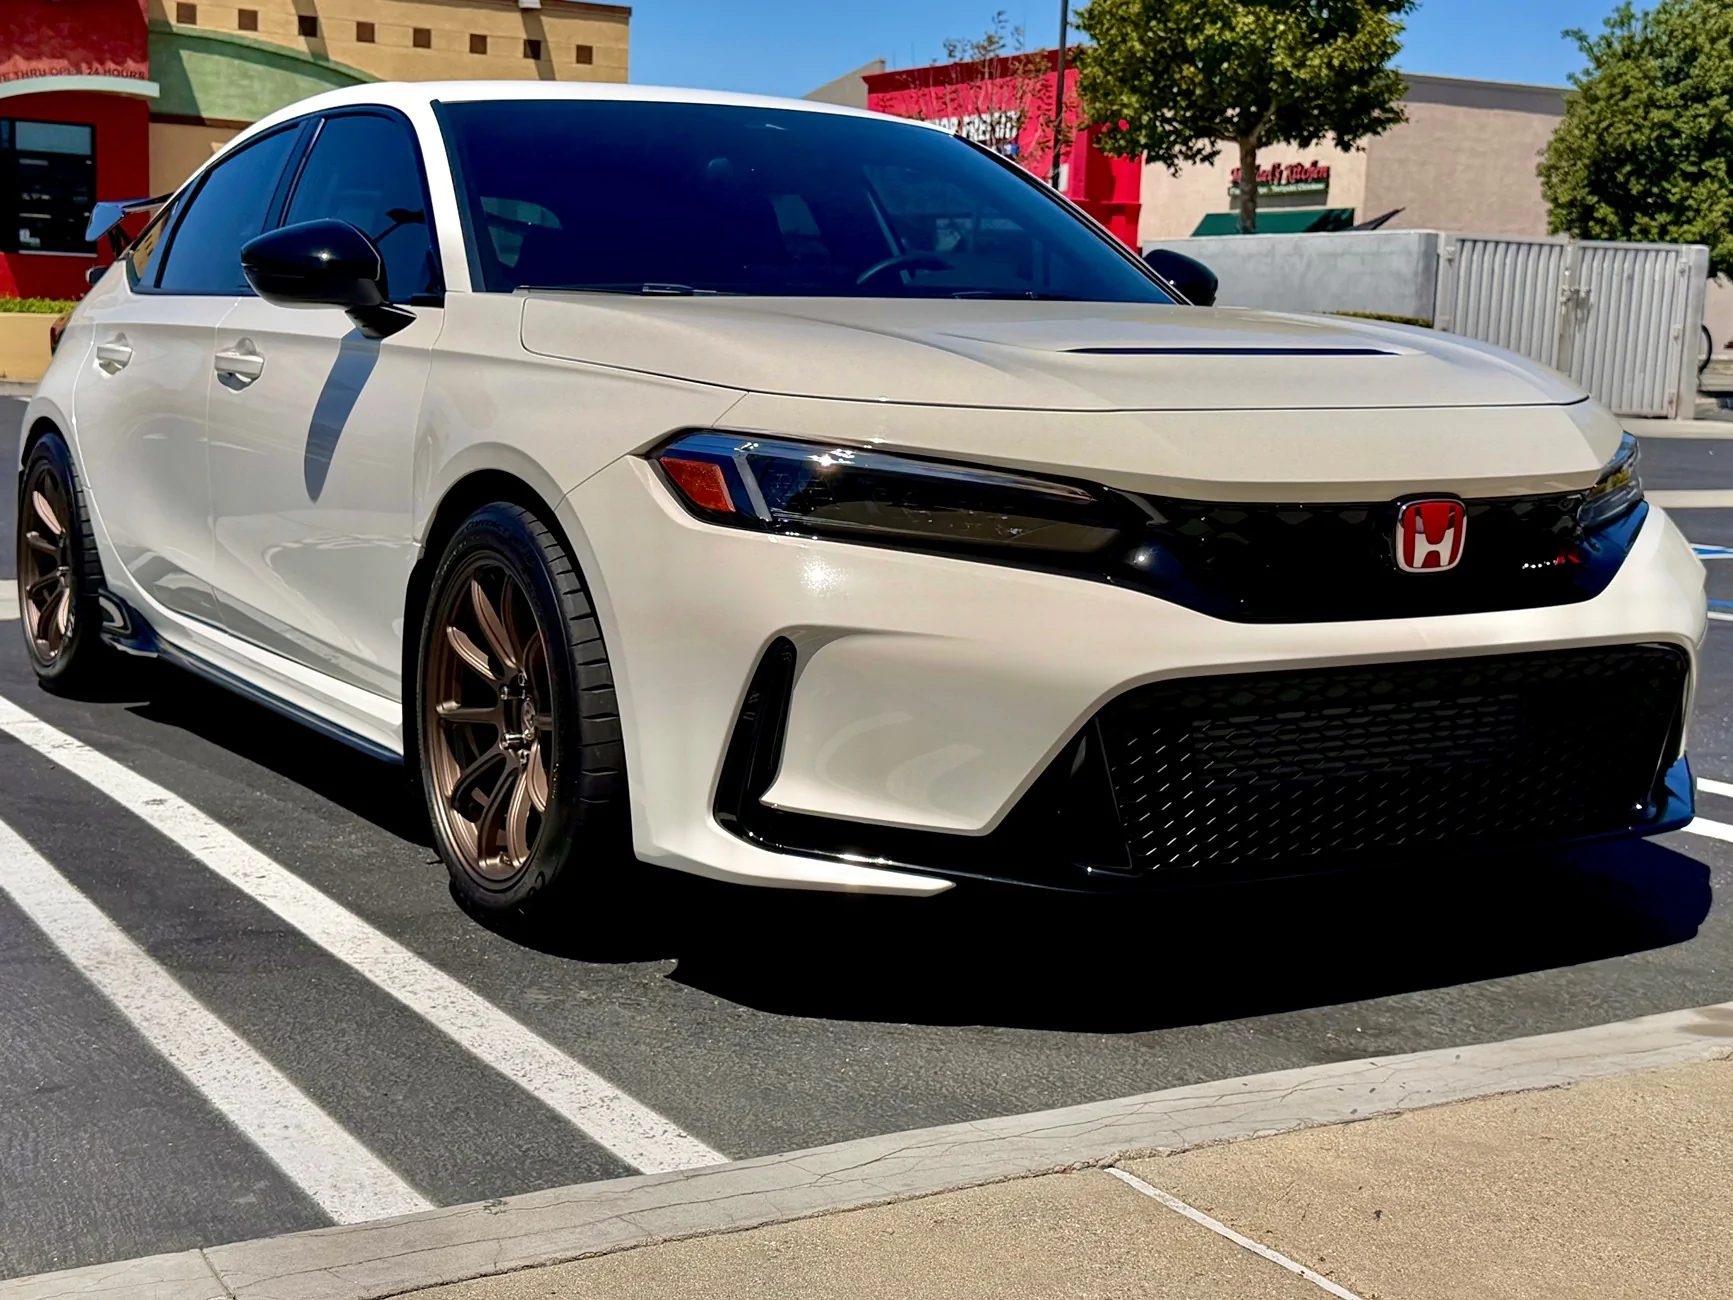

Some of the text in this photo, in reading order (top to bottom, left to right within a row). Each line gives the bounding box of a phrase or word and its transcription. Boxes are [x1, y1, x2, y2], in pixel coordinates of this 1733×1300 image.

[15, 68, 47, 80] THRU
[88, 67, 100, 76] 24
[104, 67, 146, 80] HOURS
